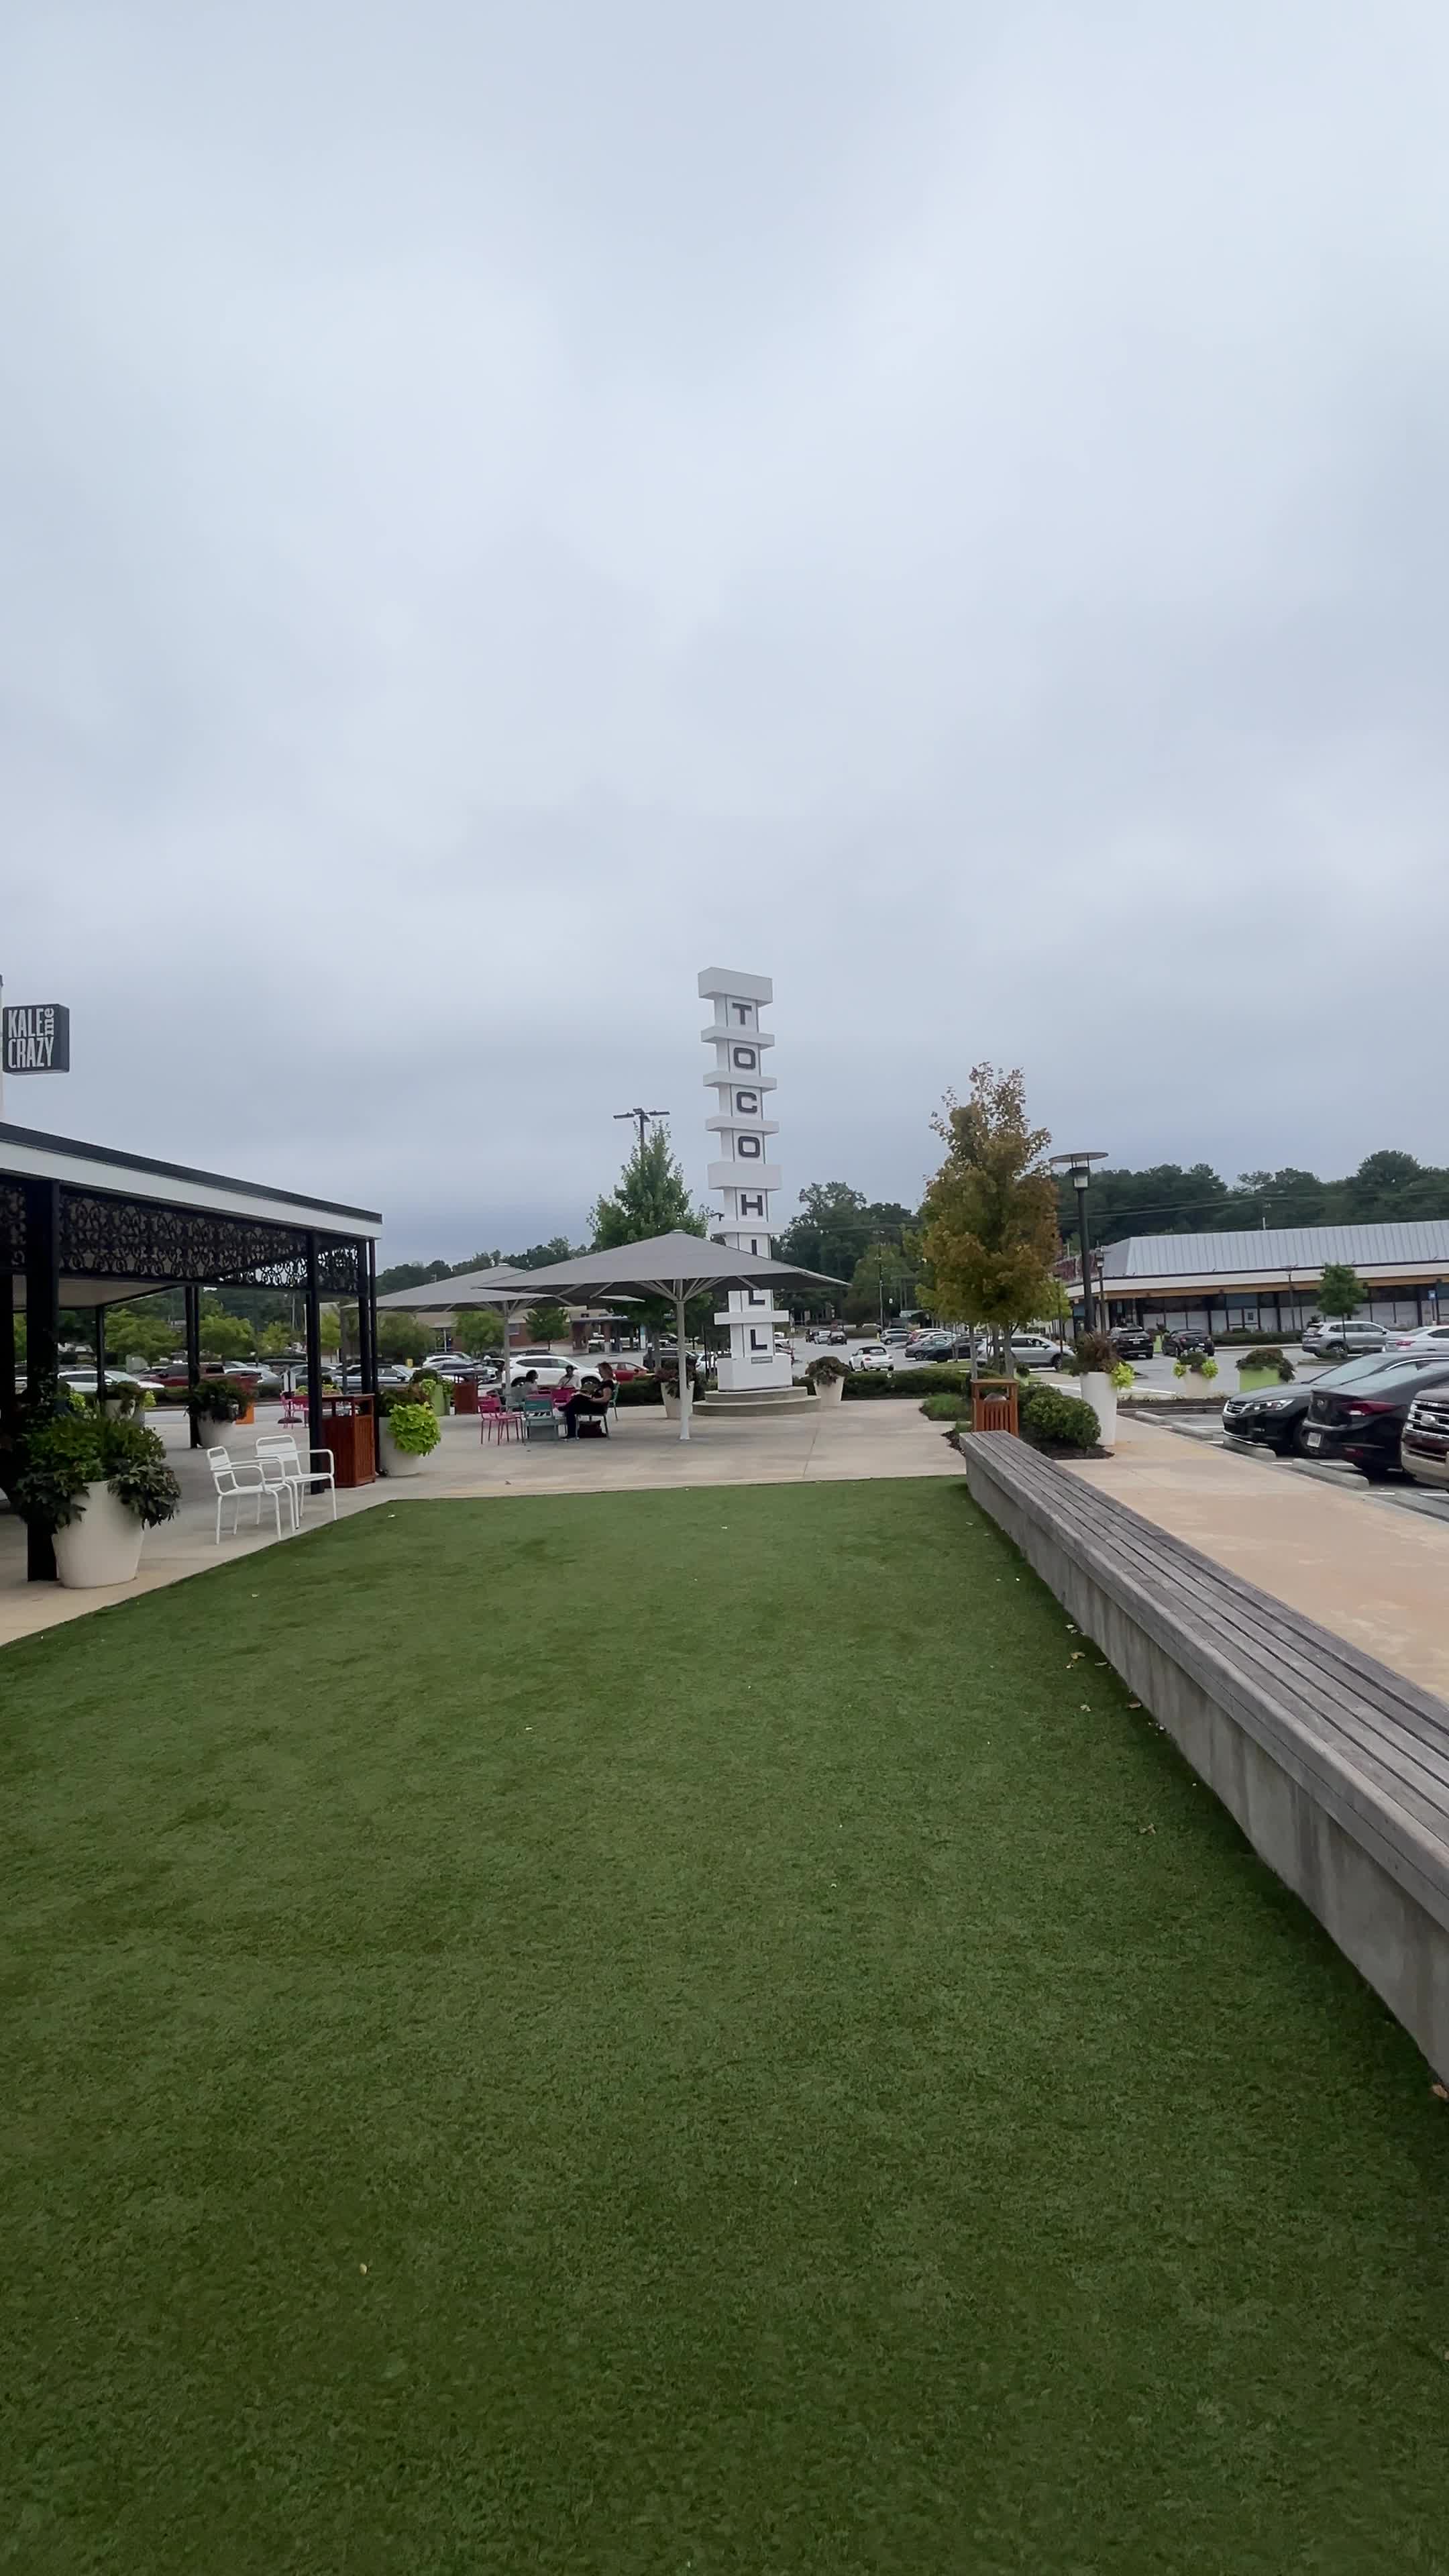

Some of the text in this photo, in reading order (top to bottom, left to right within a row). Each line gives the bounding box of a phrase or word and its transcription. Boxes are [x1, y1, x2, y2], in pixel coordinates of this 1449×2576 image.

[8, 1008, 54, 1038] KALE me
[8, 1036, 54, 1069] CRAZY
[732, 1002, 761, 1159] TOCO
[740, 1193, 768, 1350] HILL
